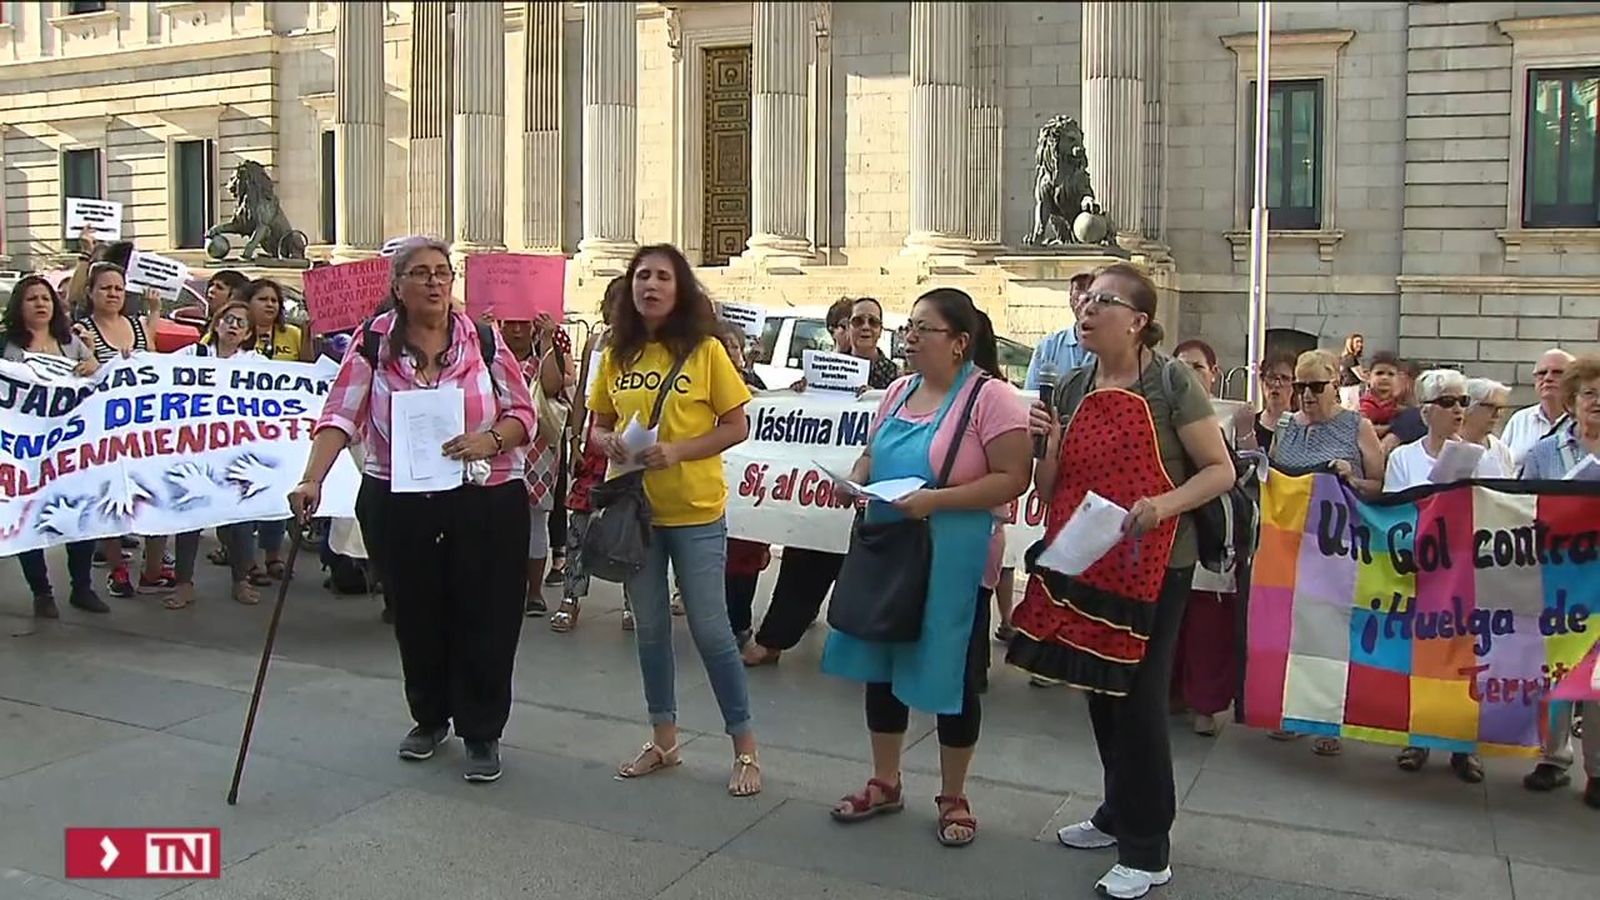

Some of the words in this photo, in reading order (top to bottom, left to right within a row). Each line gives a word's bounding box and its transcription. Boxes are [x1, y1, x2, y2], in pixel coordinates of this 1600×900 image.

[173, 366, 216, 387] DE
[104, 392, 308, 431] DERECHOS
[755, 407, 833, 445] lástima
[836, 411, 875, 446] NA
[772, 468, 799, 501] al
[1318, 500, 1373, 565] Un
[1387, 521, 1453, 575] Gol
[1473, 519, 1600, 569] contra
[1538, 589, 1591, 636] de
